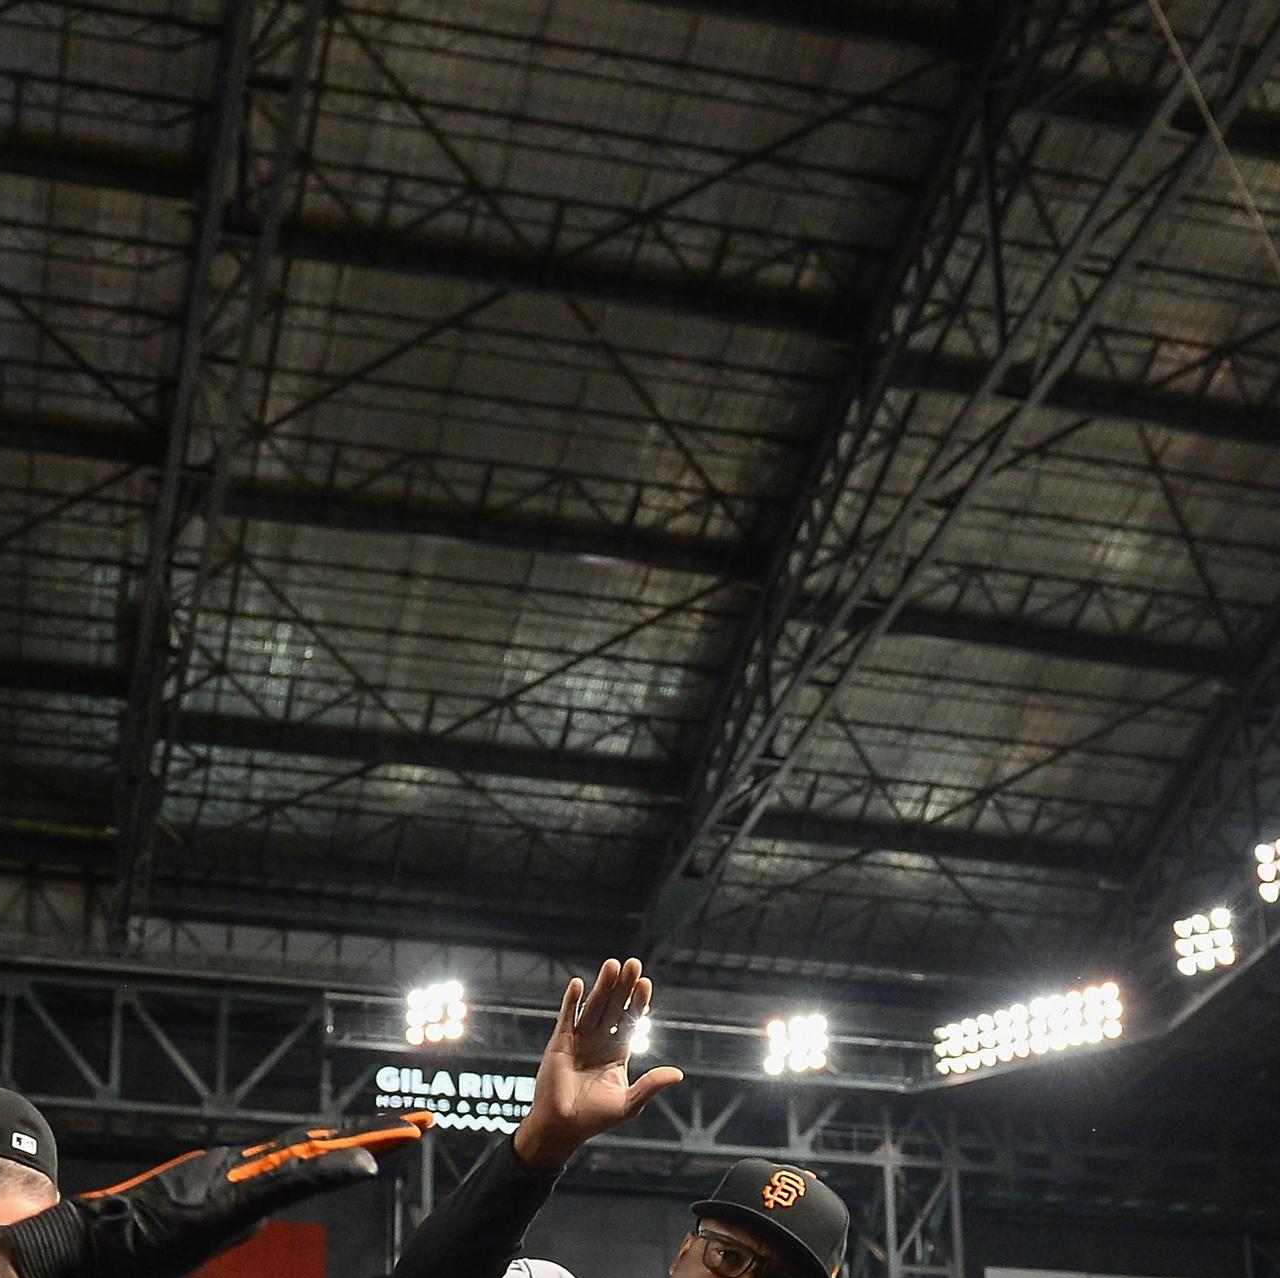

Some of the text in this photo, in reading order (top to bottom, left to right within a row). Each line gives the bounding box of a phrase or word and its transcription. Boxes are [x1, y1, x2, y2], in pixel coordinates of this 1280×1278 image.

[375, 1066, 537, 1102] GILA RIVE
[375, 1095, 451, 1112] HOTELS
